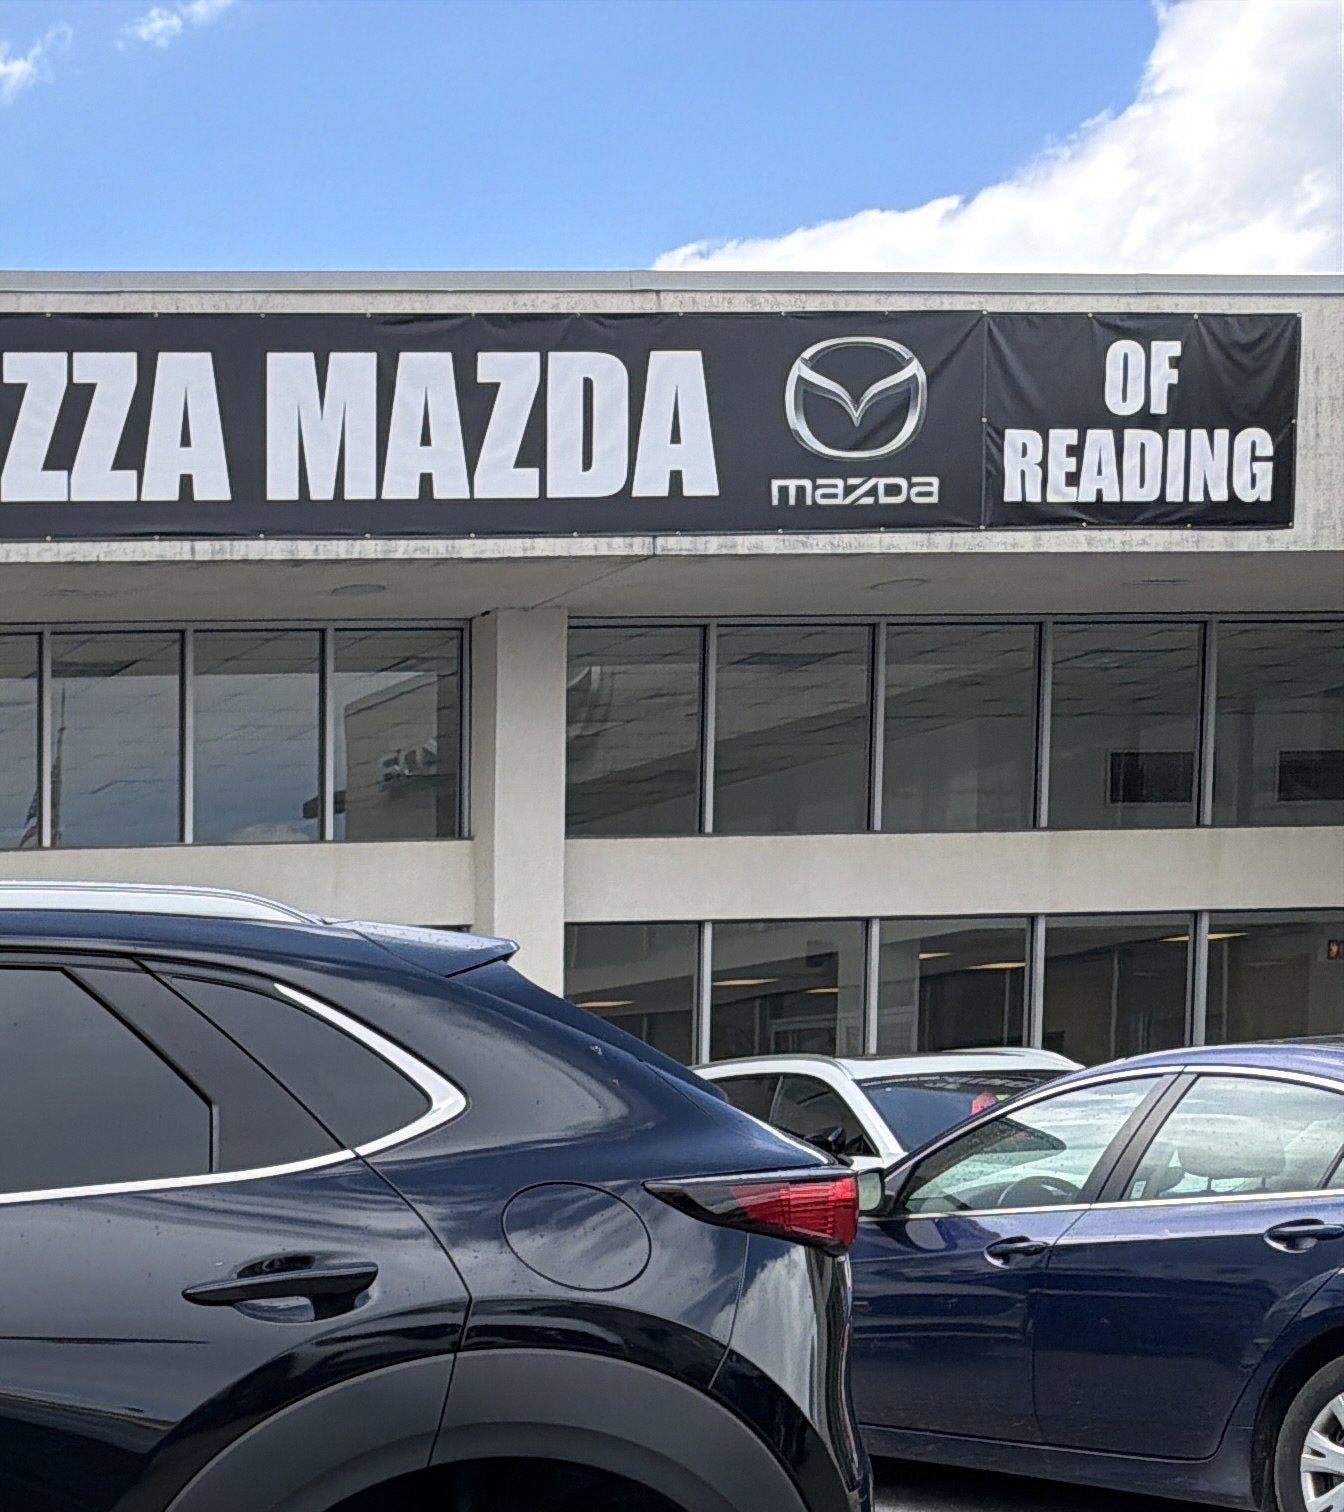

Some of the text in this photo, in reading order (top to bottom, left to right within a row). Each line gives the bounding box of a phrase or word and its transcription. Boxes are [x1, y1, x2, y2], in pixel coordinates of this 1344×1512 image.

[1104, 340, 1182, 416] OF
[266, 350, 720, 500] MAZDA
[1002, 427, 1274, 503] READING
